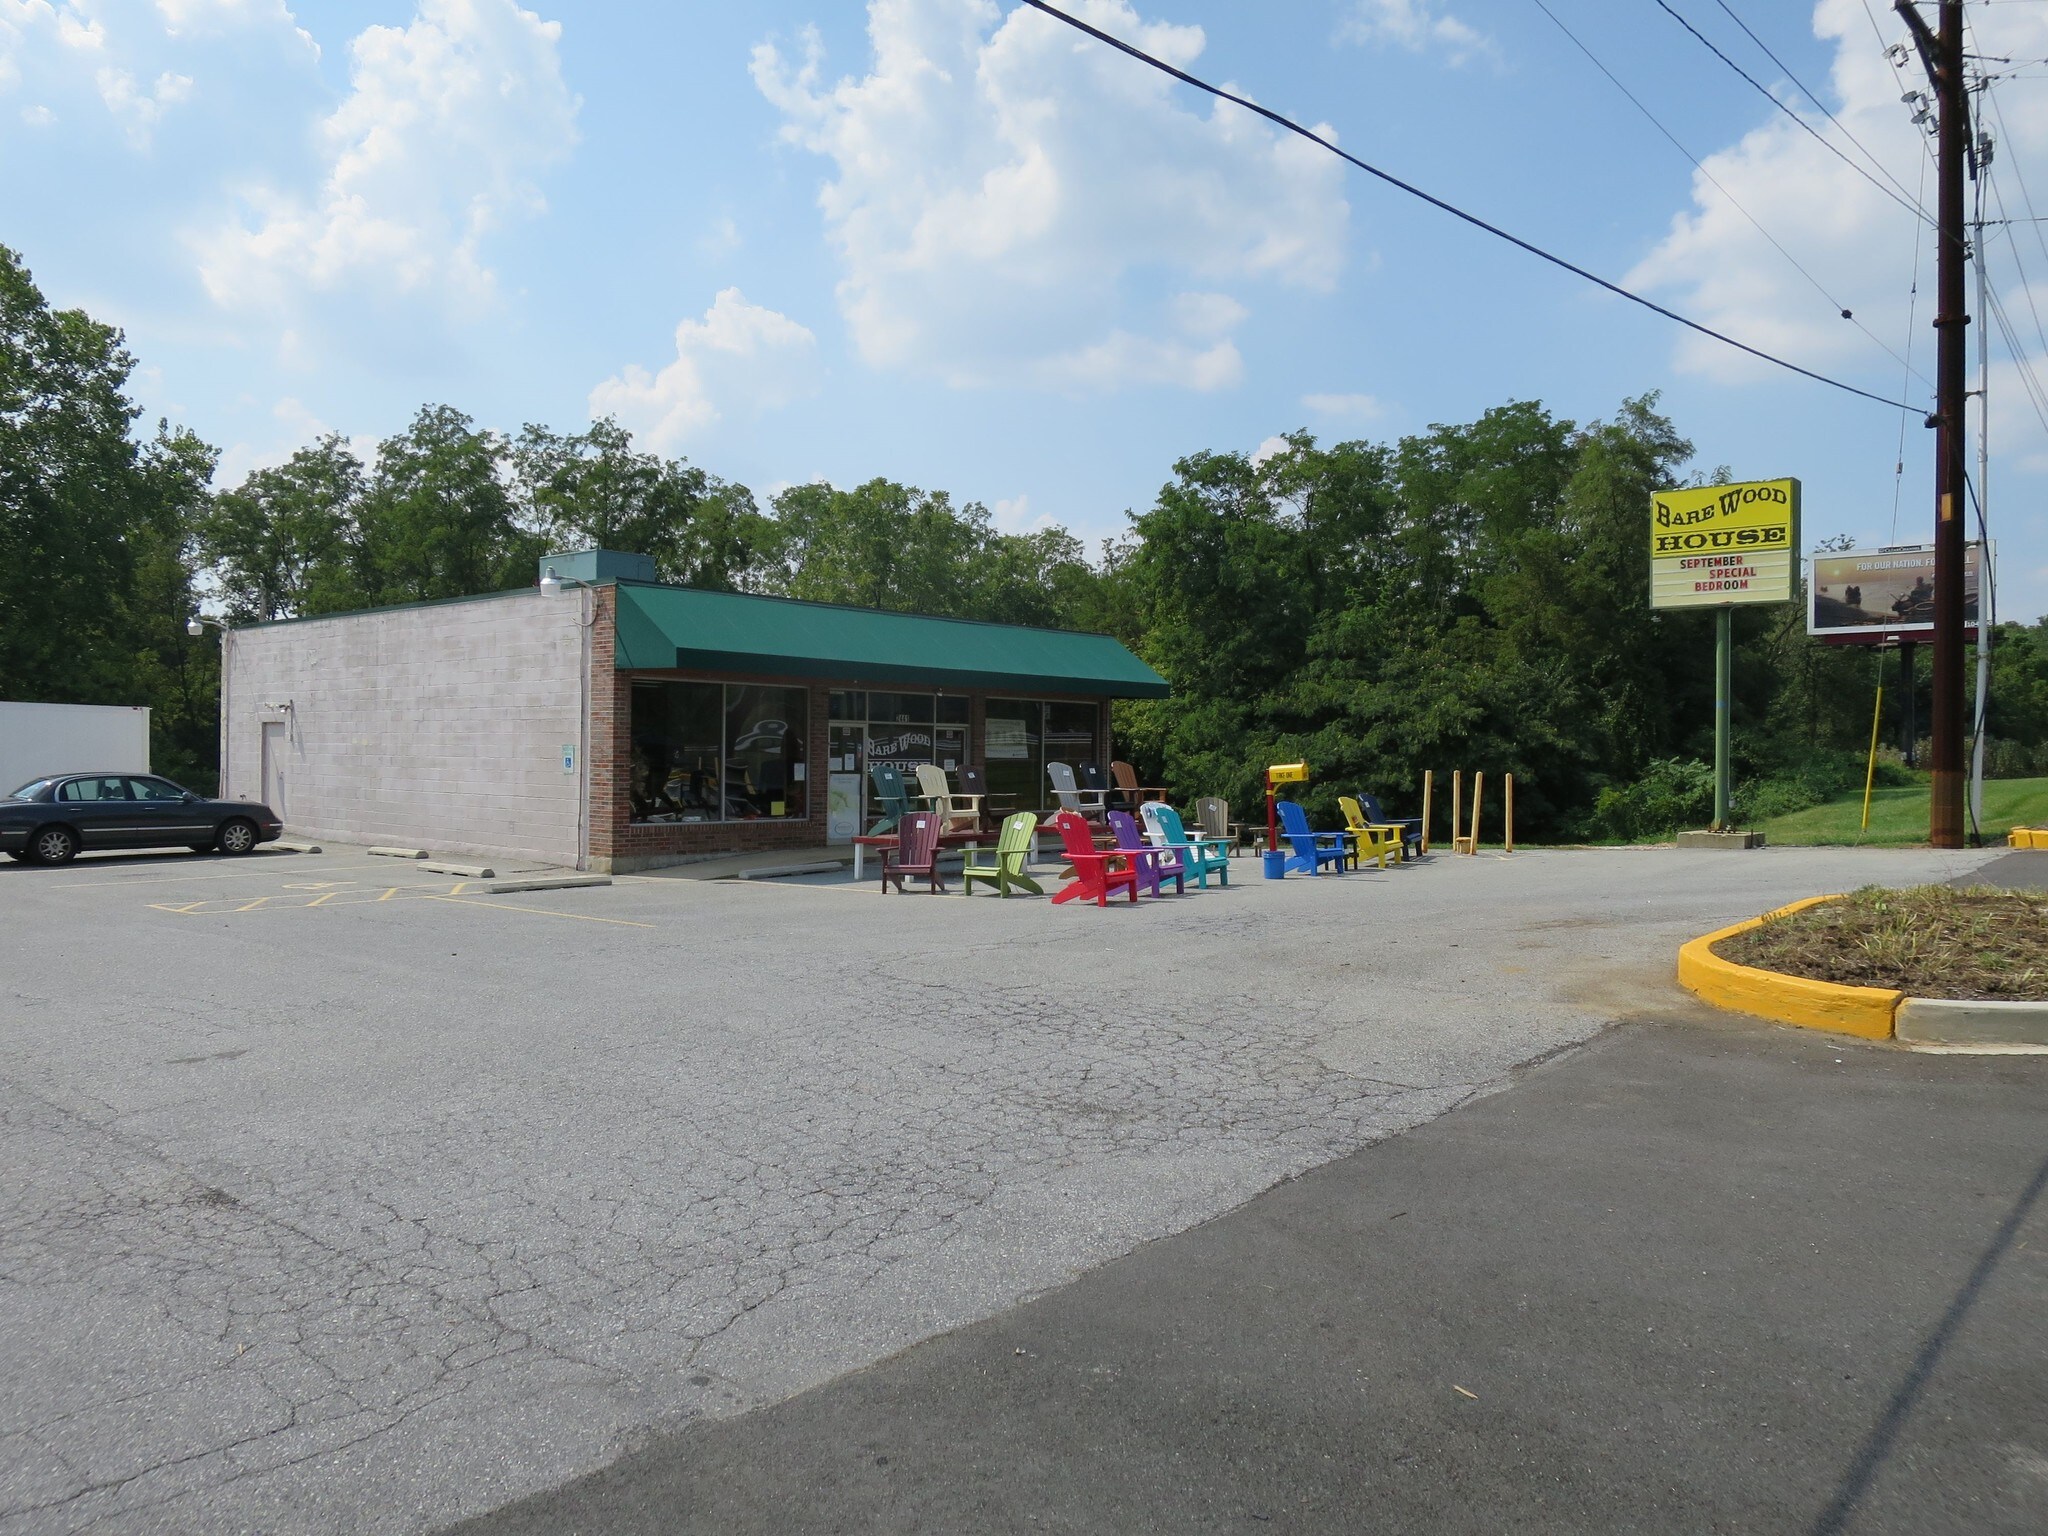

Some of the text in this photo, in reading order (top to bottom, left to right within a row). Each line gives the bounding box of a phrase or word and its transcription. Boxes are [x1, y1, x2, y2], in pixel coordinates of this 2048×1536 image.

[1656, 487, 1788, 528] BARE WOOD
[1656, 527, 1786, 551] HOUSE
[1680, 555, 1743, 569] SEPTEMBER
[1856, 562, 1873, 571] FOR
[1874, 560, 1891, 570] OUR
[1892, 558, 1924, 569] NATION.
[1709, 567, 1757, 579] SPECIAL
[1695, 580, 1749, 592] BEDROOM
[868, 732, 931, 757] BARE WOOD
[868, 761, 931, 772] HOUS
